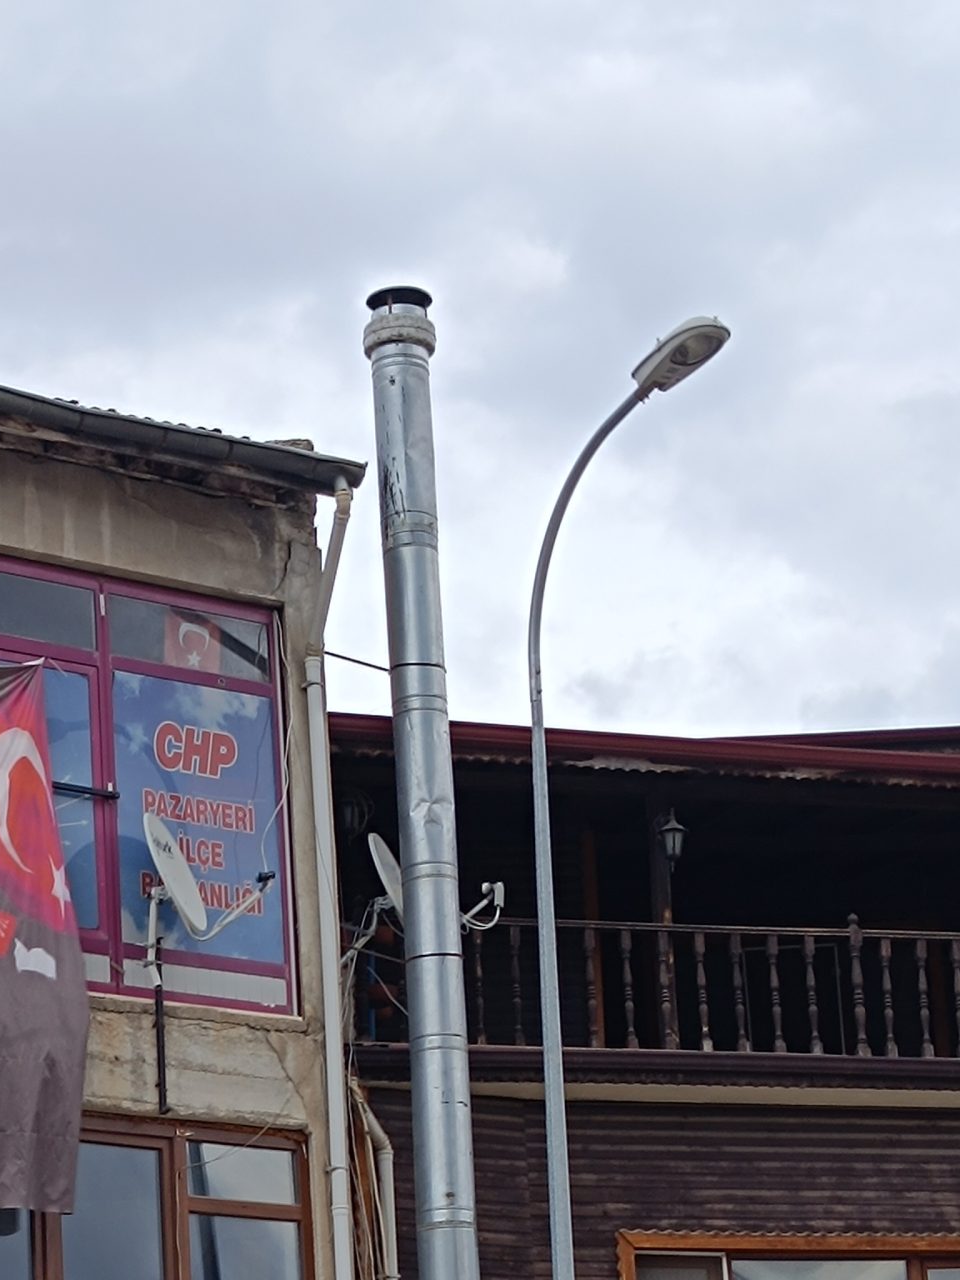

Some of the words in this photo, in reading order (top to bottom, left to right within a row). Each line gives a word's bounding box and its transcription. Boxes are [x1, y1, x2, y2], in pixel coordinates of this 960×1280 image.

[154, 721, 238, 779] CHP
[143, 788, 255, 834] PAZARYERİ
[178, 829, 224, 873] İLÇE
